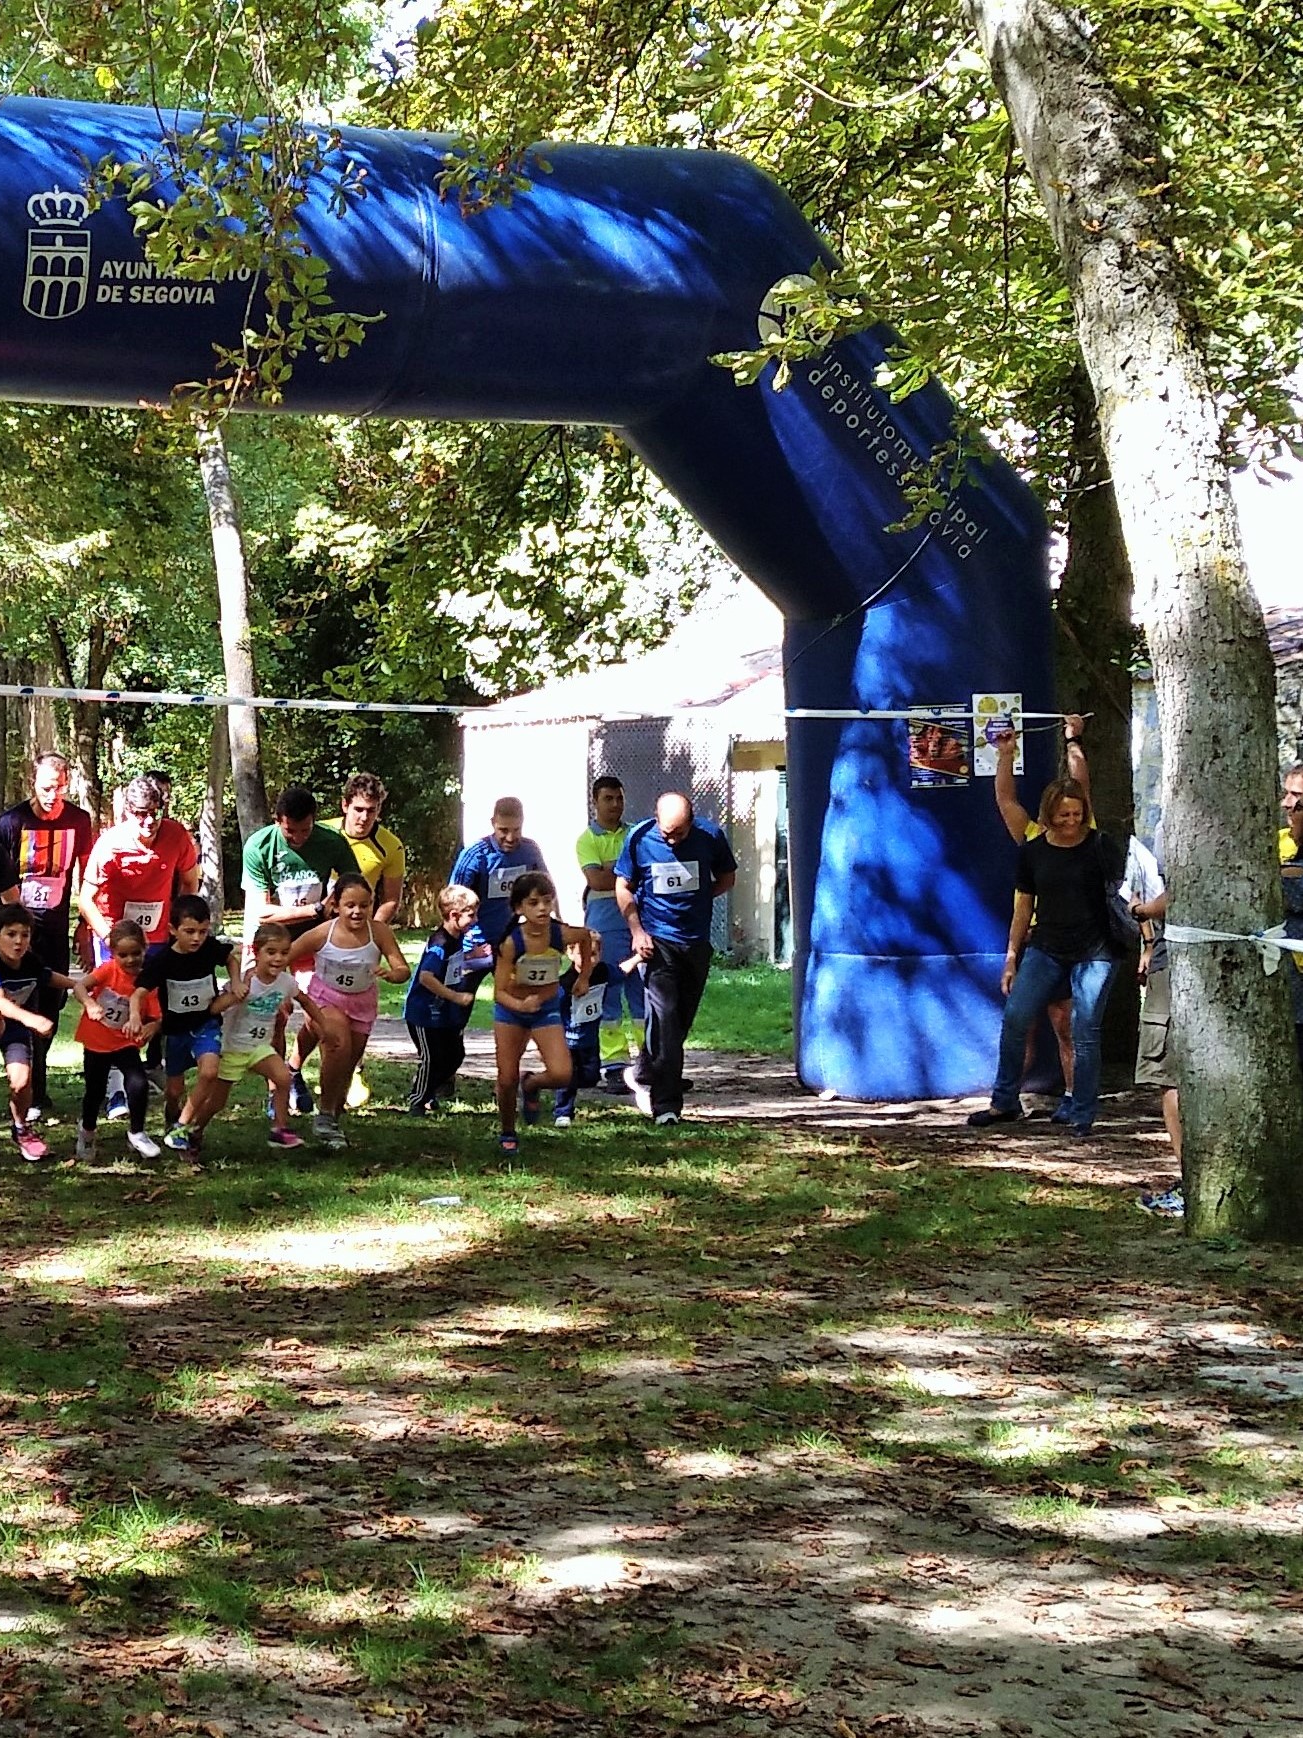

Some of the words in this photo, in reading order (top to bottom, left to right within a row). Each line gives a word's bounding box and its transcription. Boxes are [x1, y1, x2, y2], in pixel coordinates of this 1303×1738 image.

[96, 284, 125, 304] DE
[128, 284, 216, 305] SEGOVIA
[666, 876, 682, 888] 61
[135, 914, 152, 926] 49
[335, 974, 354, 987] 45
[527, 970, 547, 981] 37
[181, 995, 199, 1007] 43
[104, 1007, 123, 1022] 21
[585, 1002, 598, 1016] 61
[248, 1027, 266, 1039] 49
